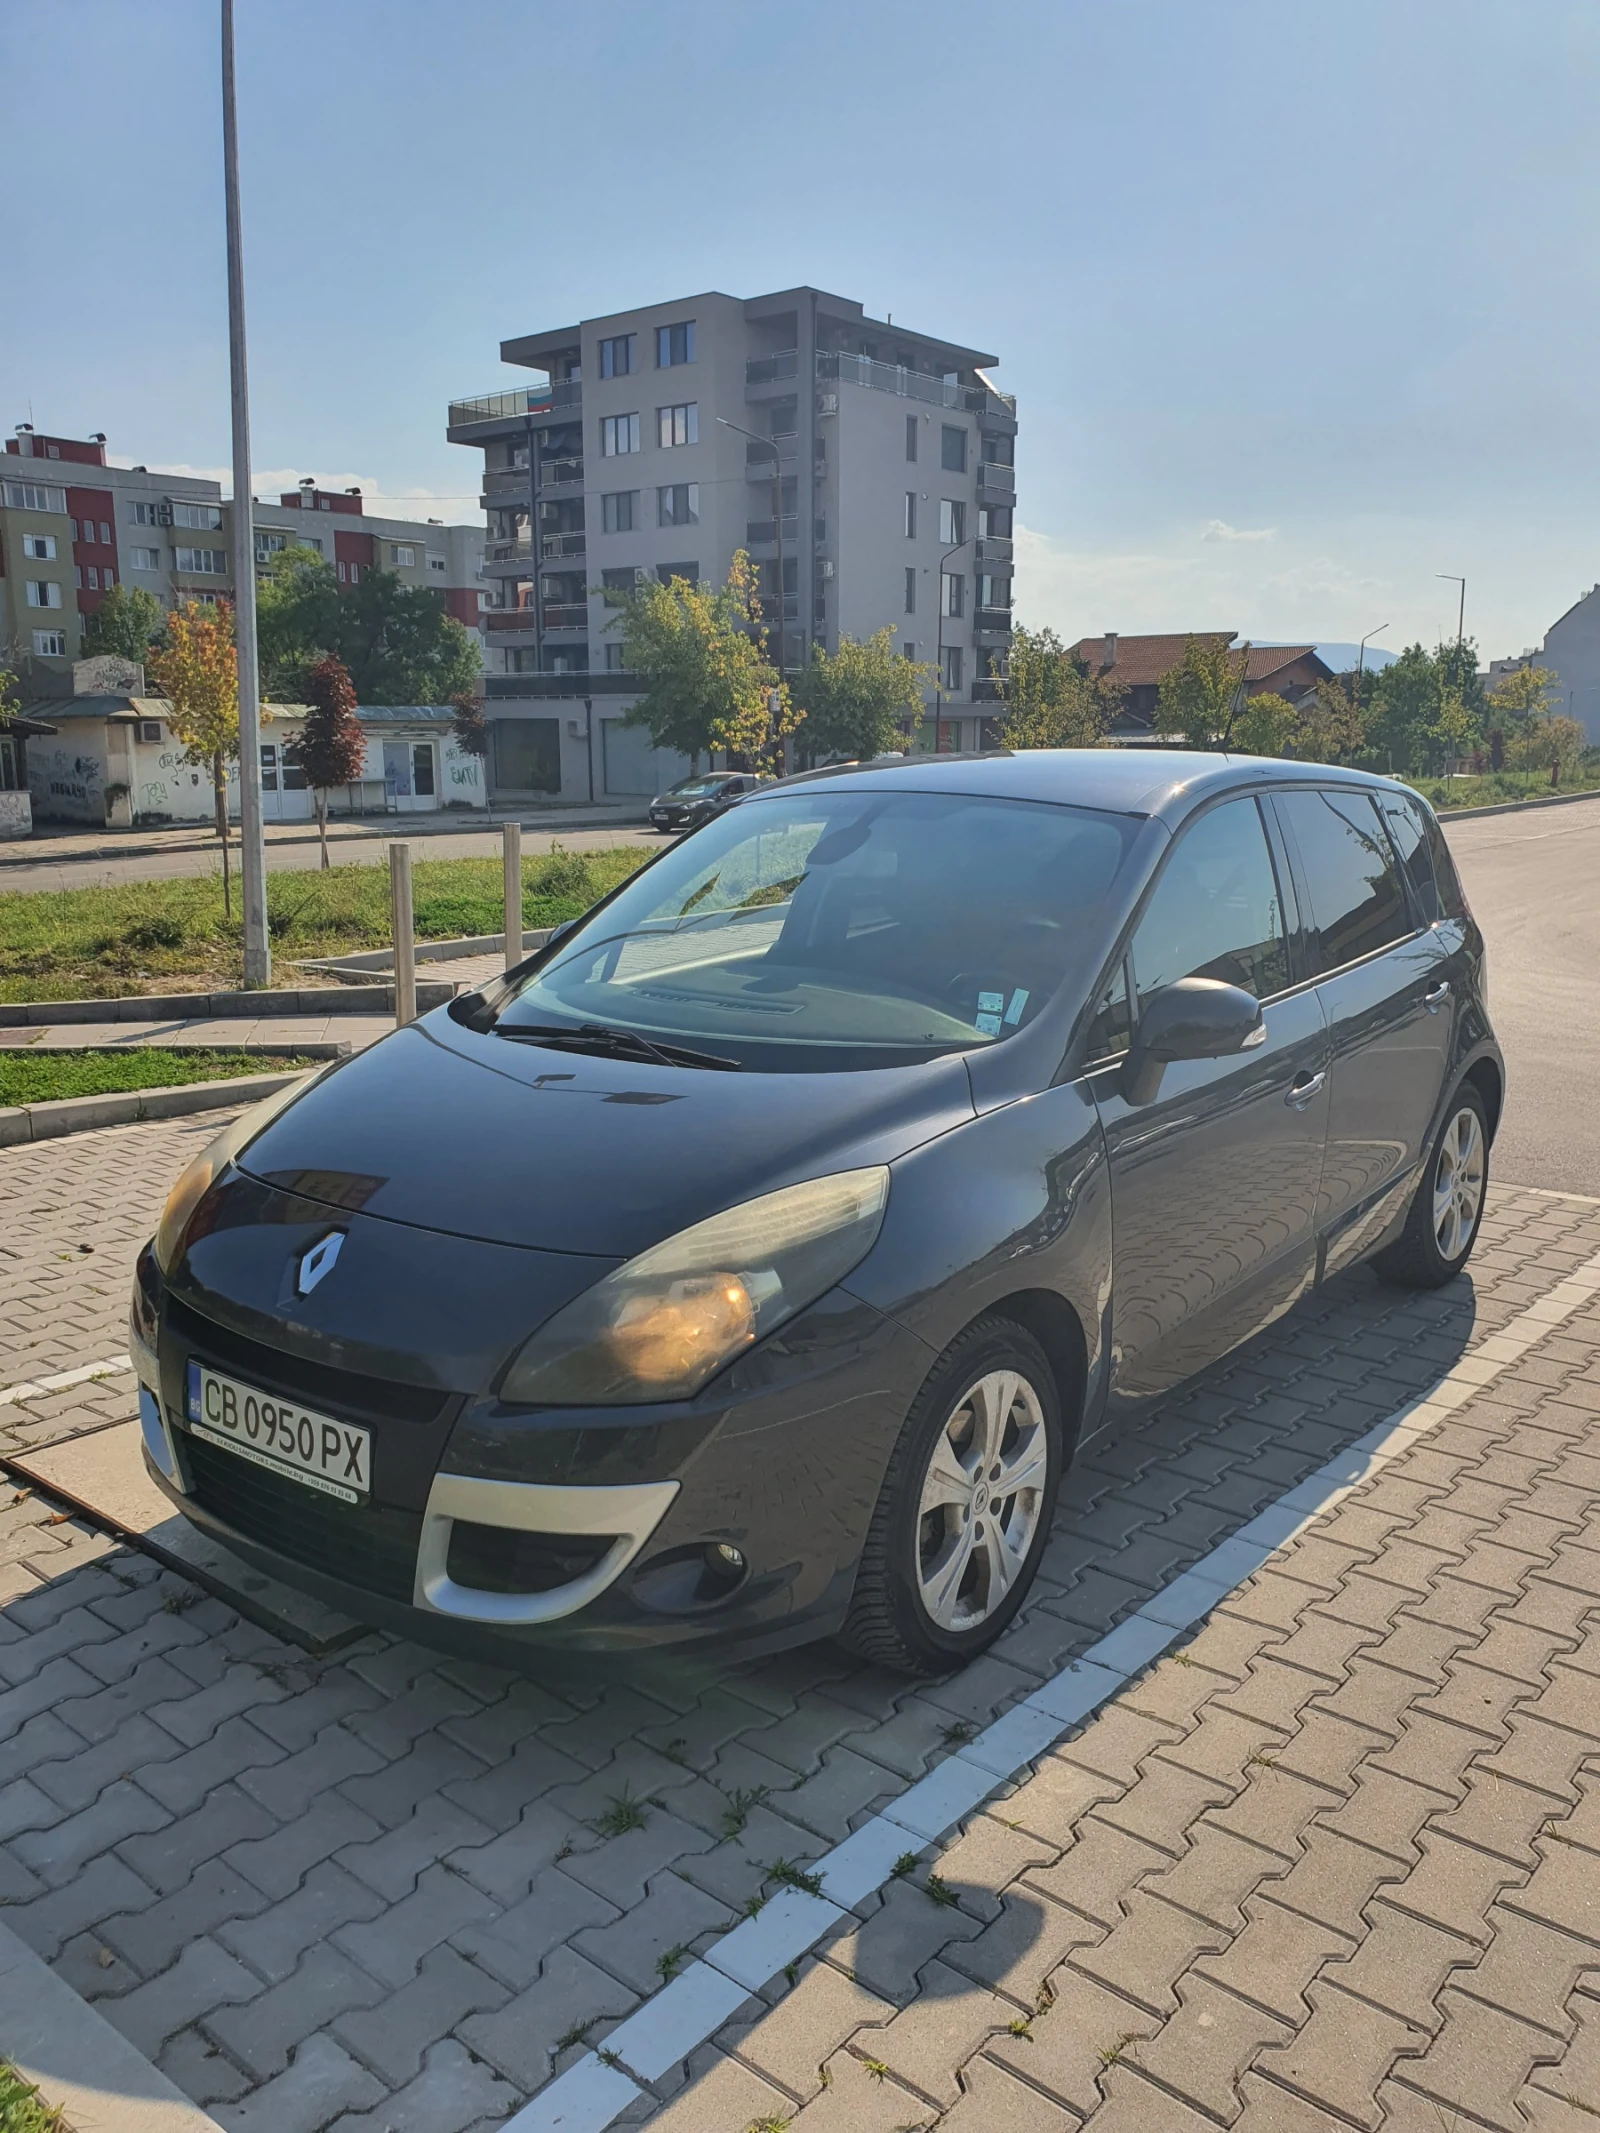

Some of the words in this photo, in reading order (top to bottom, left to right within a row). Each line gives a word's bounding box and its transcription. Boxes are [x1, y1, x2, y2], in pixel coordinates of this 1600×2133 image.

[190, 1397, 201, 1412] BG
[205, 1378, 239, 1431] CB
[244, 1395, 315, 1462] 0950
[321, 1423, 364, 1483] PX
